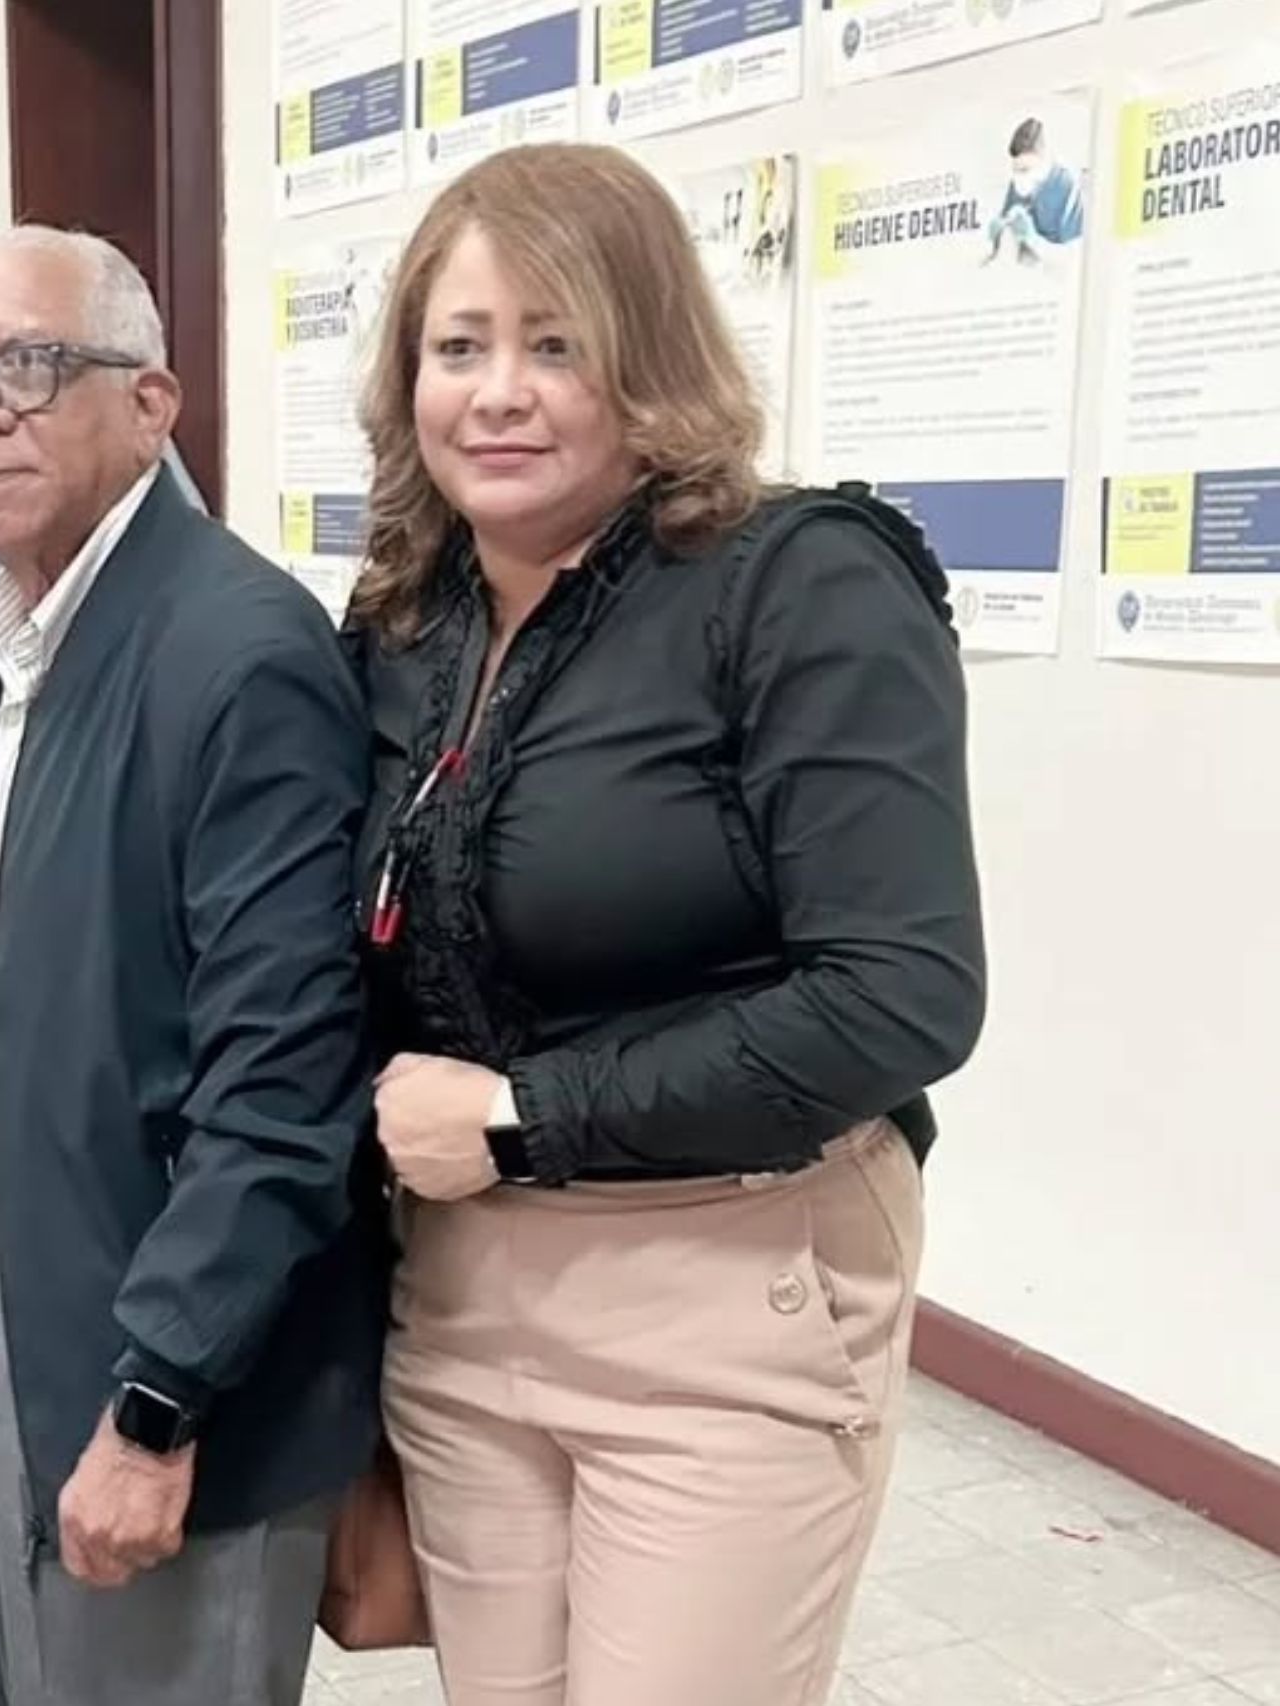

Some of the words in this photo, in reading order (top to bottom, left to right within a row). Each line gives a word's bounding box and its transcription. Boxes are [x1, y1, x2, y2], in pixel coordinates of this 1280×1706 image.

[1142, 174, 1225, 222] DENTAL
[834, 212, 905, 250] HIGIENE
[909, 198, 981, 239] DENTAL
